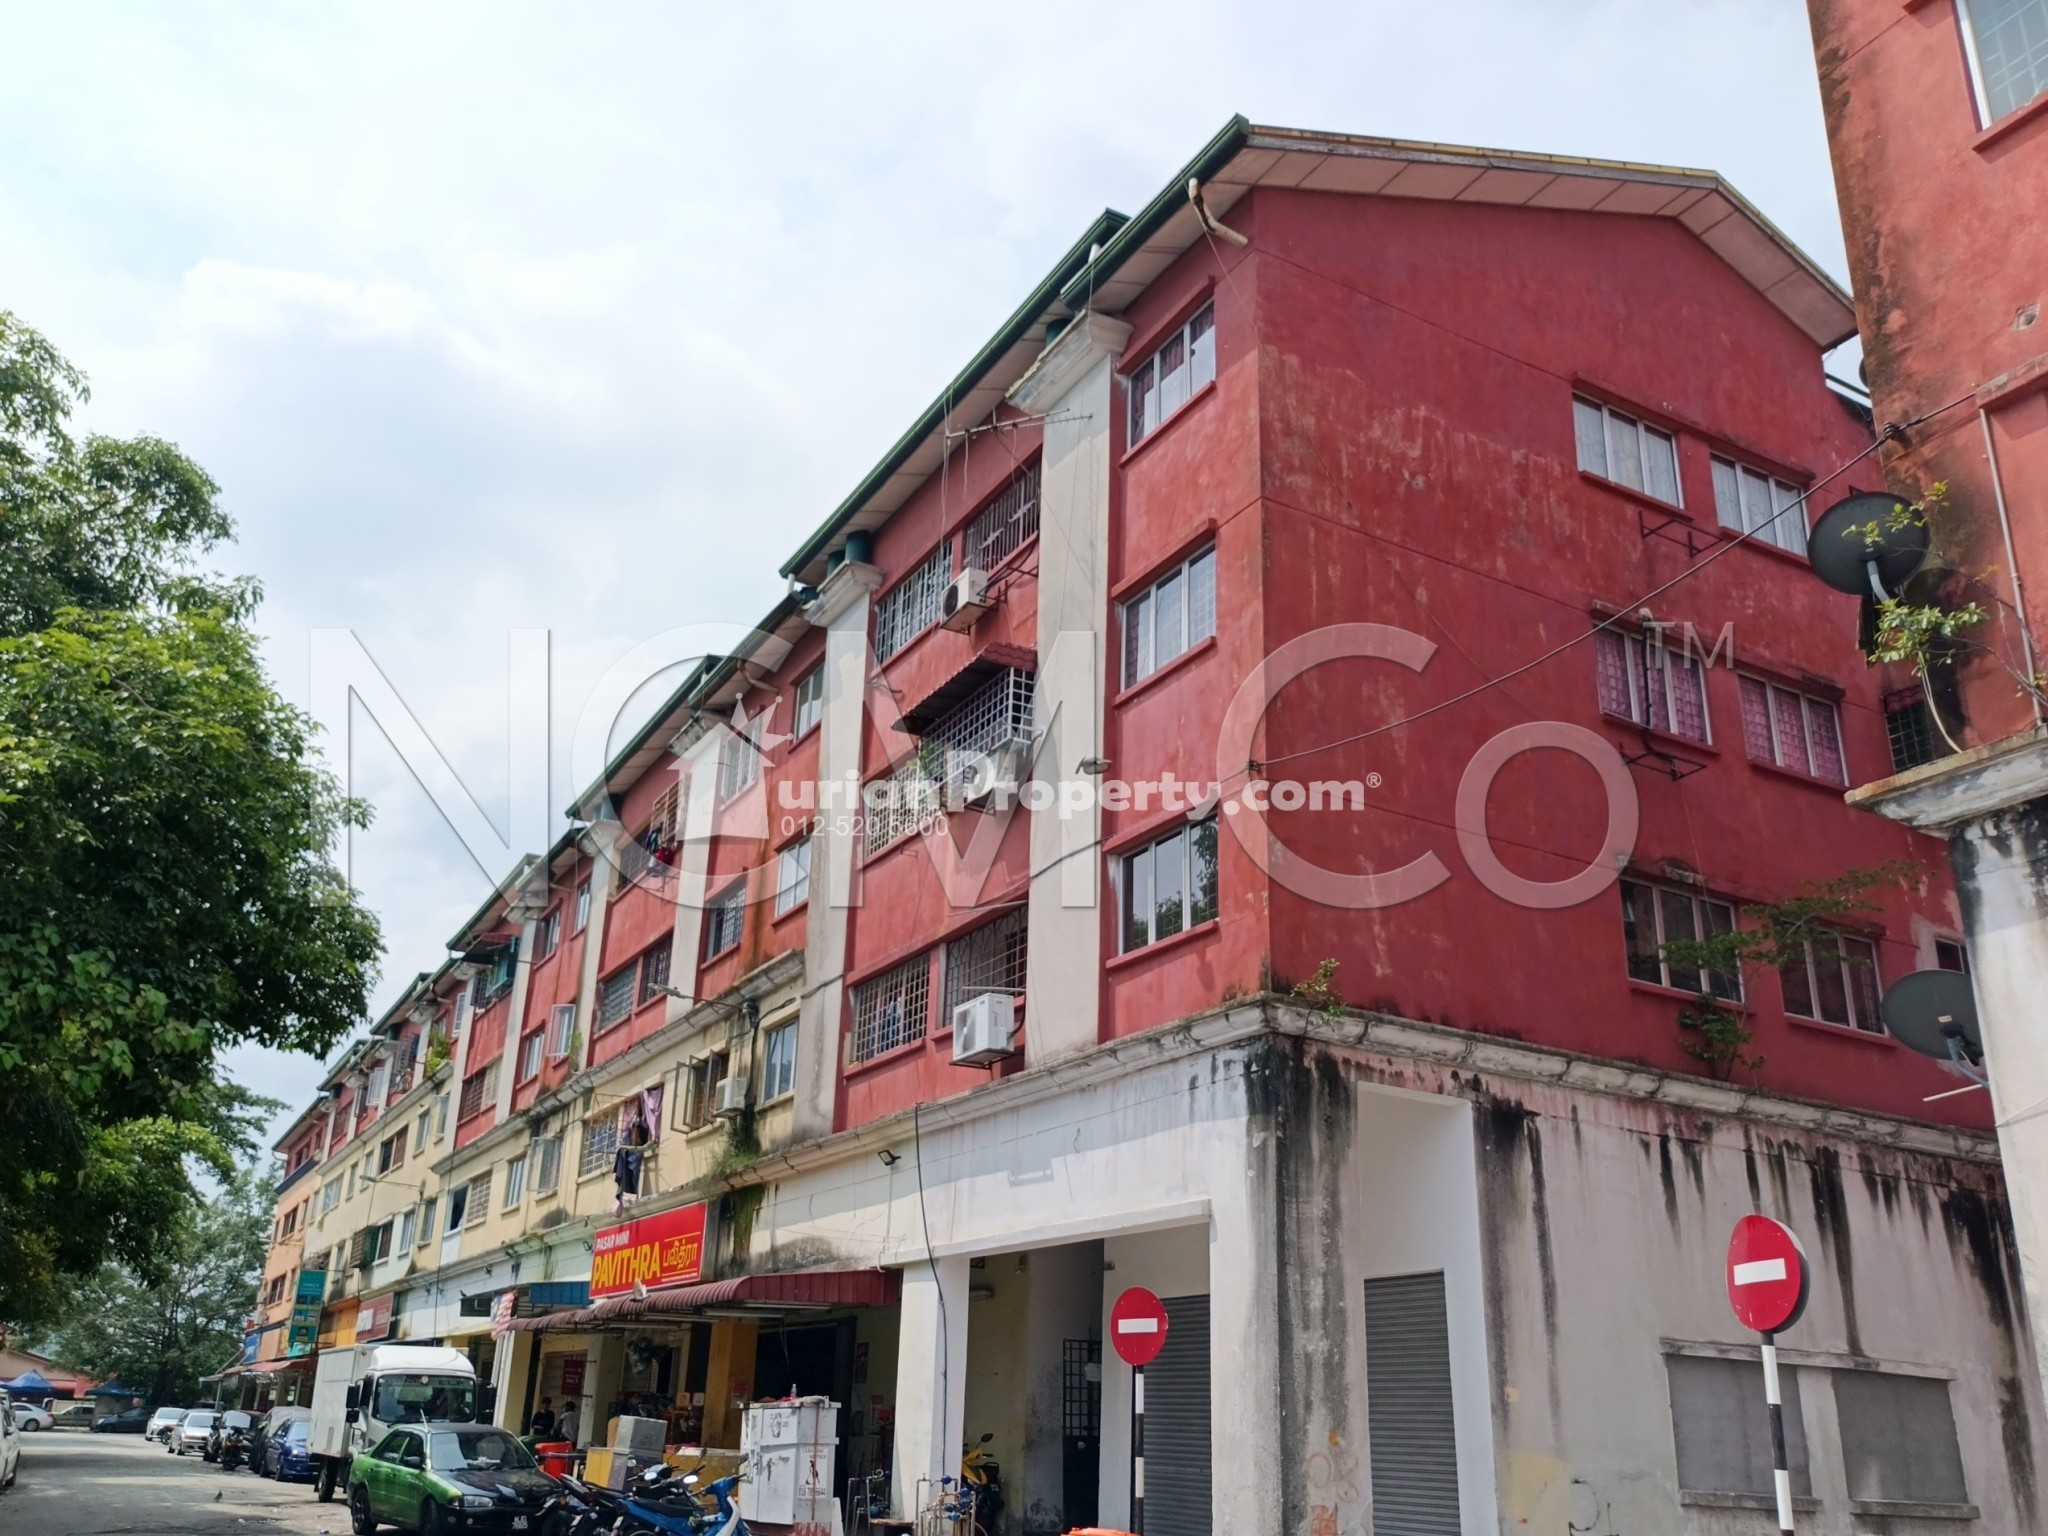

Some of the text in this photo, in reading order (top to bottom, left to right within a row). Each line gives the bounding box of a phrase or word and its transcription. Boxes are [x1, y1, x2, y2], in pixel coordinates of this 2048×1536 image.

[596, 1230, 630, 1252] PASAR MINI
[593, 1241, 660, 1289] PAVITHRA
